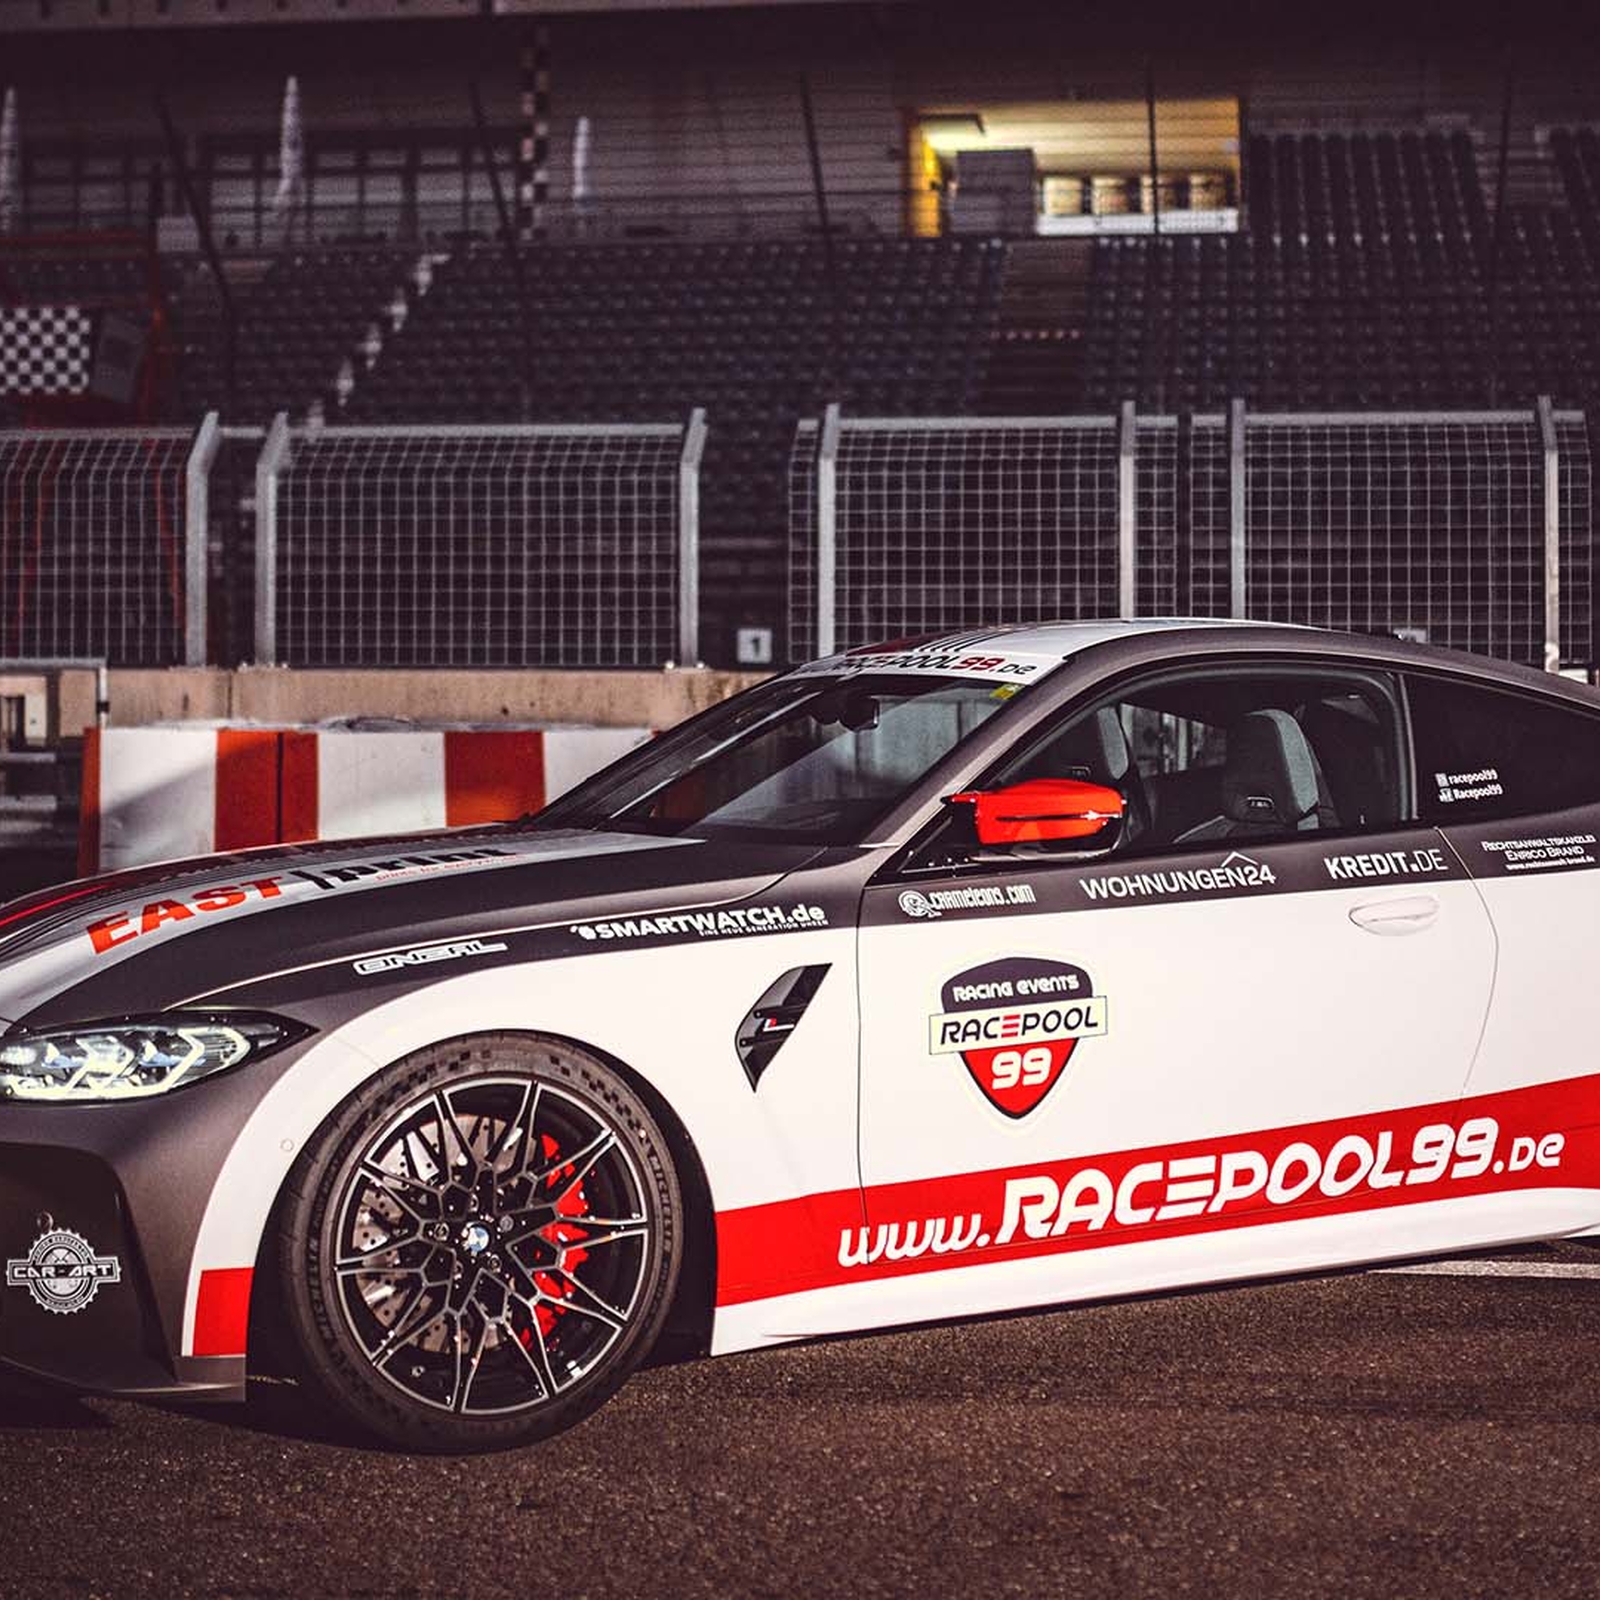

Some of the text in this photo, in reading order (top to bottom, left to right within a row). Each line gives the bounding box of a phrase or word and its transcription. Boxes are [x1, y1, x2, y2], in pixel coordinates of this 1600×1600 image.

[752, 637, 761, 658] 1
[1079, 864, 1277, 900] WOHNUNGEN24
[1324, 849, 1449, 880] KREDIT.DE
[86, 876, 283, 955] EAST
[594, 904, 826, 939] SMARTWATCH.de
[940, 1006, 1099, 1045] RACEPOOL
[992, 1047, 1052, 1090] 99
